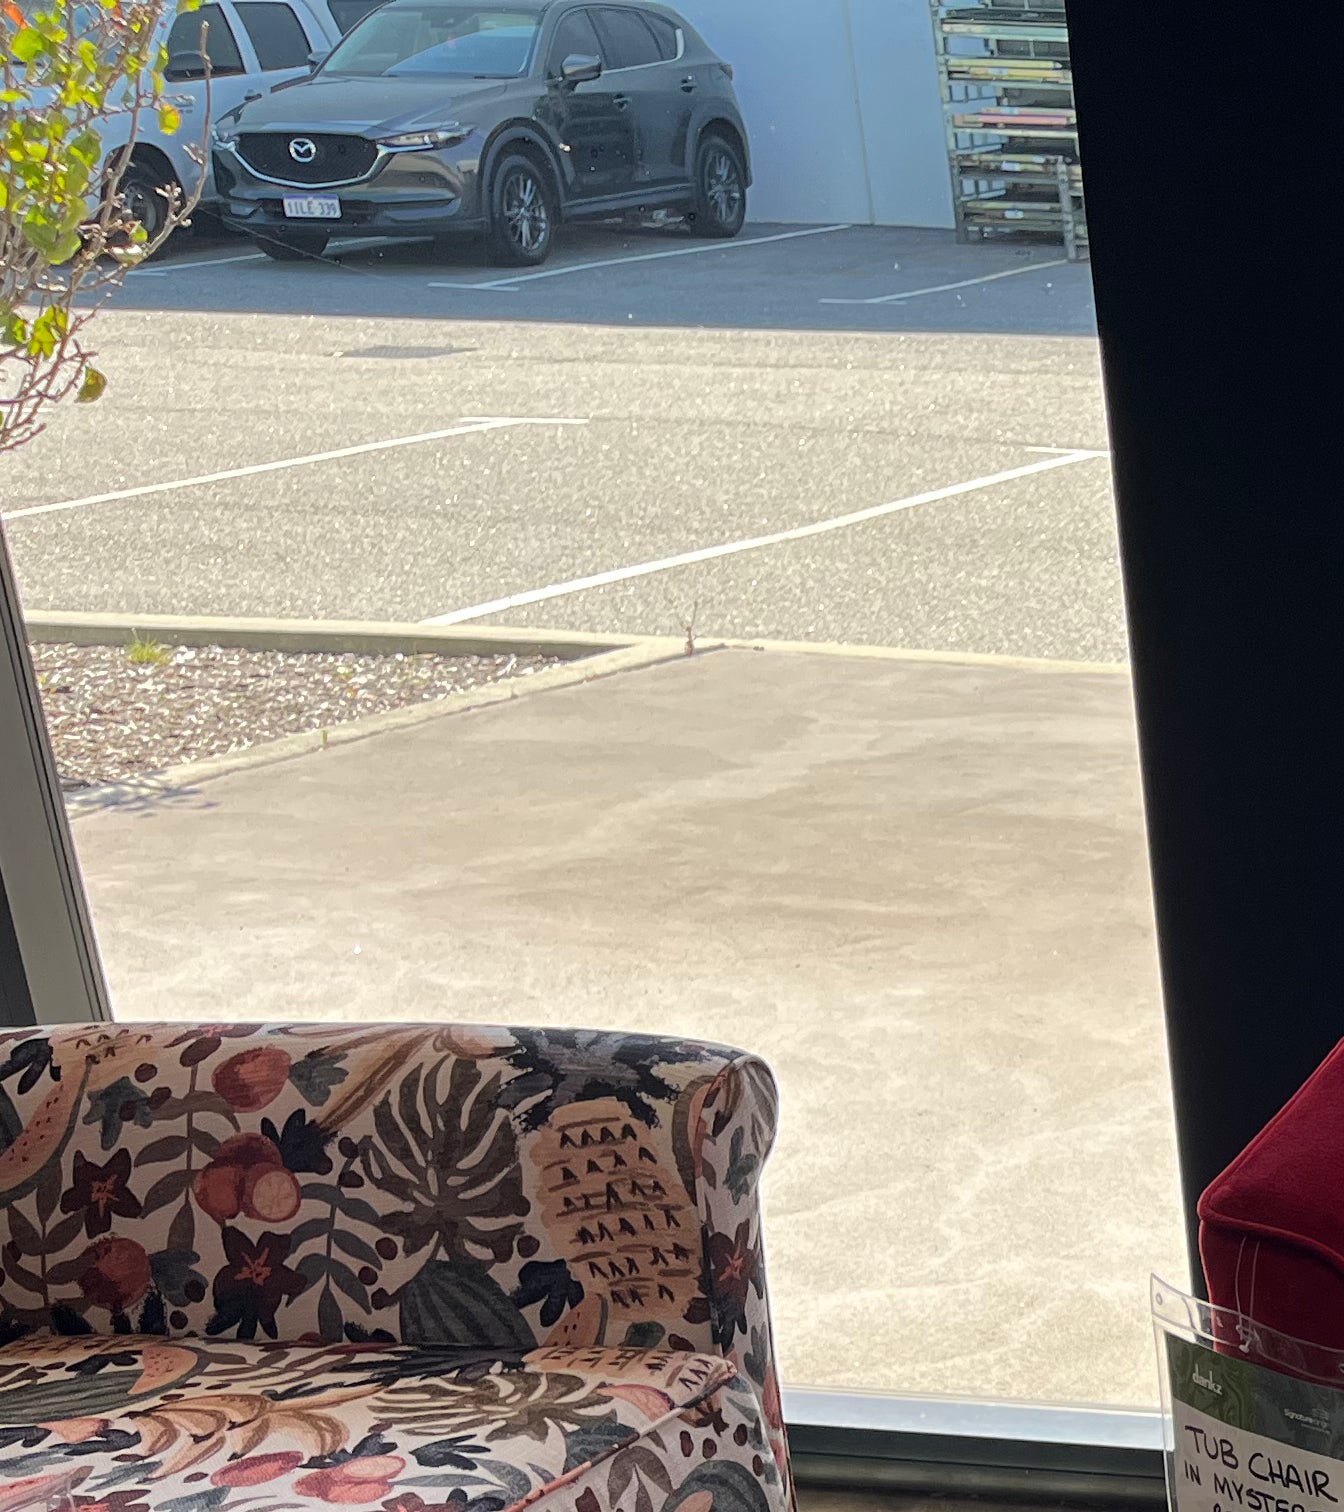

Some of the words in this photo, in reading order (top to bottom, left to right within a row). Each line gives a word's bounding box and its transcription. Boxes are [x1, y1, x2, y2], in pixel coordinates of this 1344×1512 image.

[1184, 1461, 1202, 1486] IN
[1185, 1425, 1238, 1469] TUB
[1248, 1453, 1338, 1502] CHAIR
